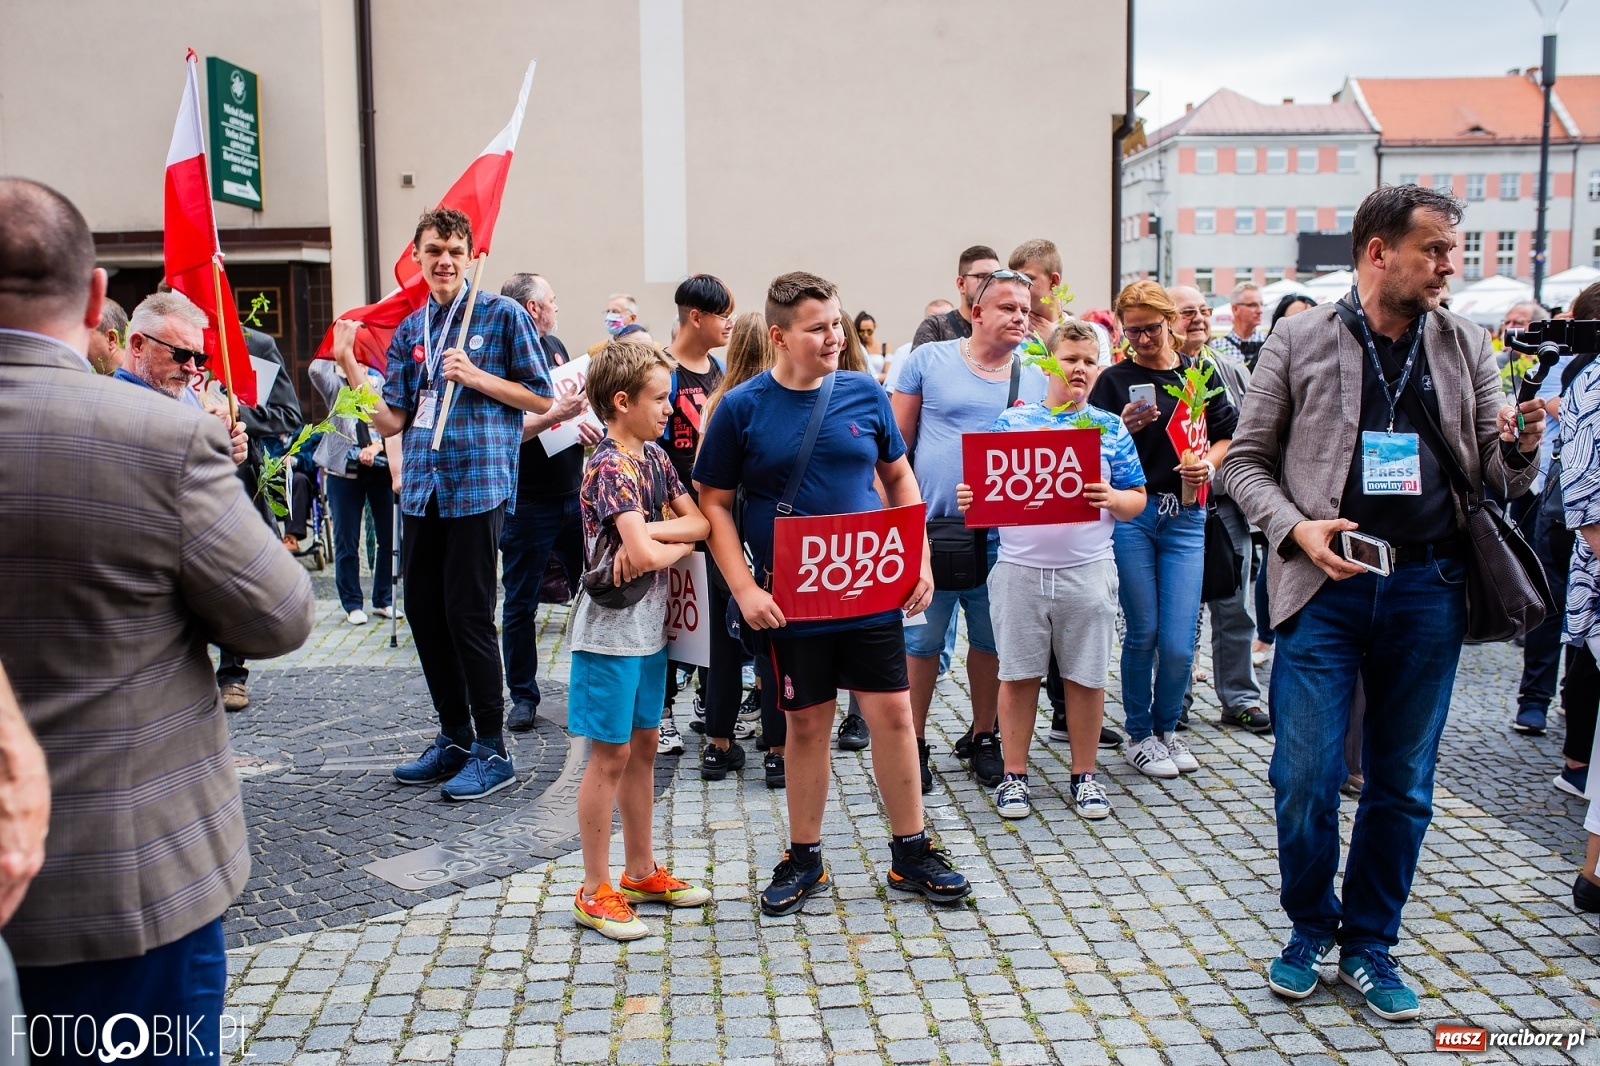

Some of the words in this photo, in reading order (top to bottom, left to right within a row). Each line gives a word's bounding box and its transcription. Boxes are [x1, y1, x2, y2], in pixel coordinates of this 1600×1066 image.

[986, 446, 1083, 476] DUDA
[1369, 467, 1413, 477] PRESS
[984, 472, 1083, 502] 2020
[1368, 481, 1415, 491] nowiny.pl
[801, 526, 905, 565] DUDA
[669, 567, 697, 601] DA
[796, 554, 905, 593] 2020
[902, 833, 922, 844] PUMA
